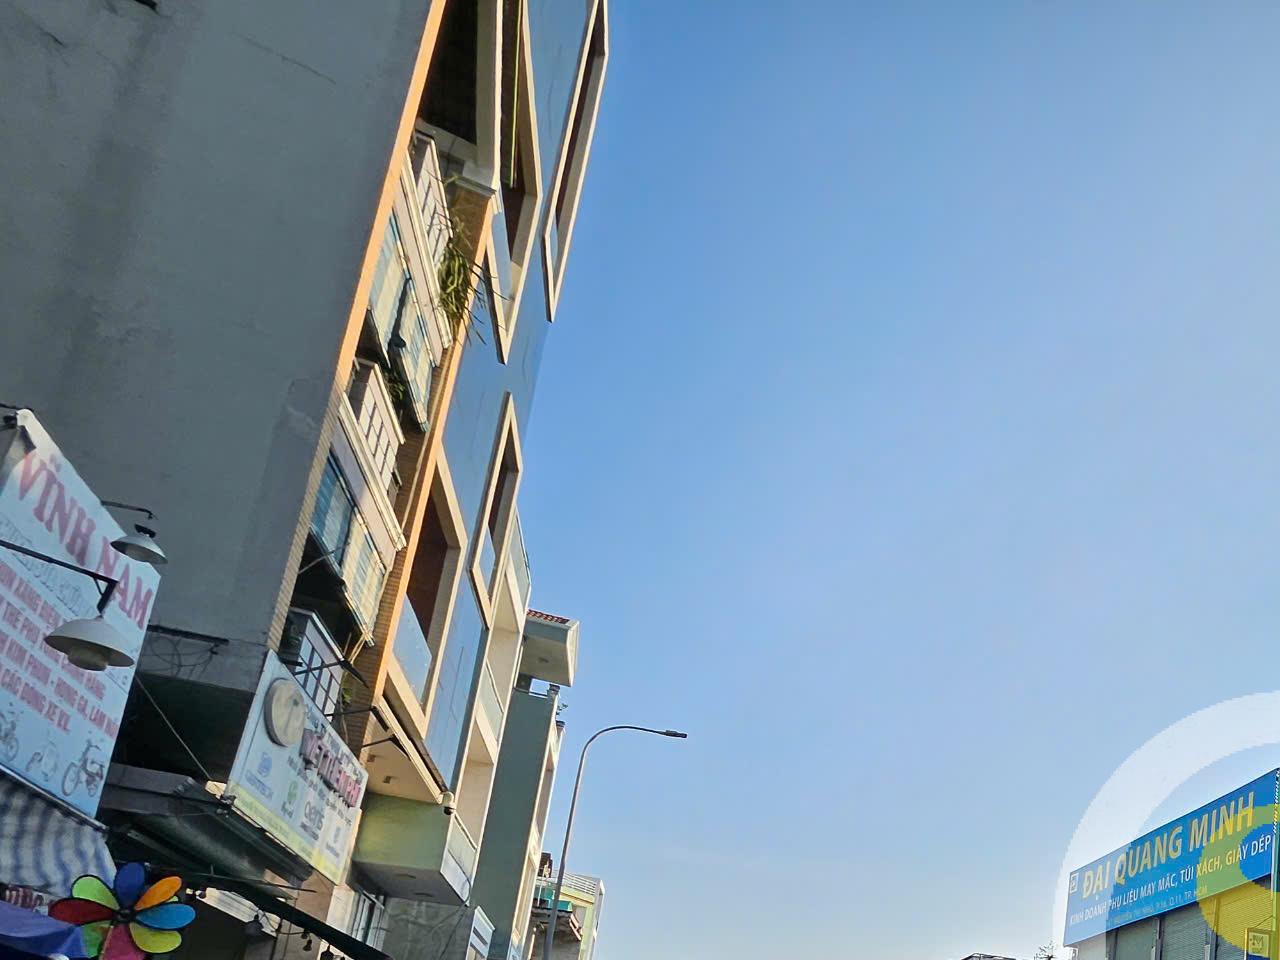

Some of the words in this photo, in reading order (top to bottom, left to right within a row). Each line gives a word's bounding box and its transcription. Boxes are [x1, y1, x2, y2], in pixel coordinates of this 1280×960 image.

[96, 536, 153, 630] NAM
[1082, 860, 1111, 901] ĐẠI
[1113, 825, 1184, 886] QUANG
[1189, 791, 1255, 852] MINH
[1070, 907, 1084, 925] KINH
[1084, 902, 1108, 921] DOANH
[1108, 894, 1122, 910] PHỤ
[1122, 887, 1139, 907] LIỆU
[1140, 881, 1157, 898] MAY
[1179, 865, 1195, 883] TÚI
